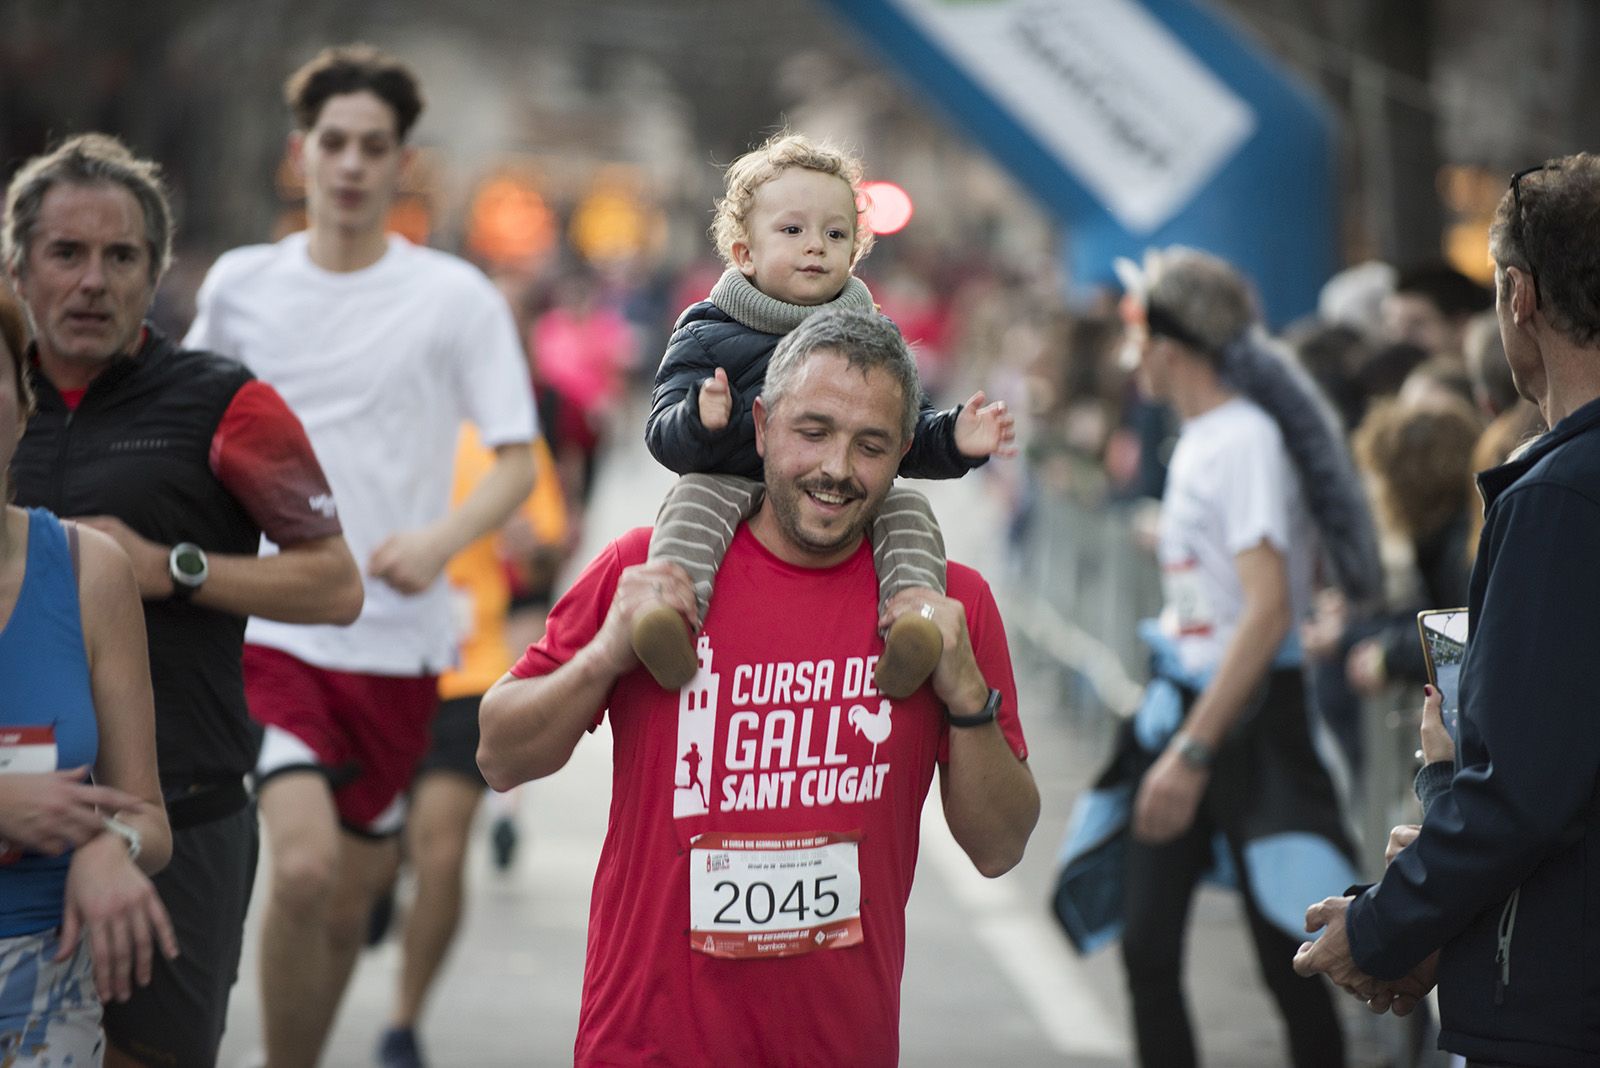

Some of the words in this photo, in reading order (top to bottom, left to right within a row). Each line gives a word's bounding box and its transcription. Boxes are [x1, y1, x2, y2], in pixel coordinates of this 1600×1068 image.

[731, 659, 835, 706] CURSA
[842, 655, 886, 698] DE
[725, 705, 848, 771] GALL
[720, 771, 796, 812] SANT
[800, 763, 890, 807] CUGAT
[713, 874, 840, 924] 2045
